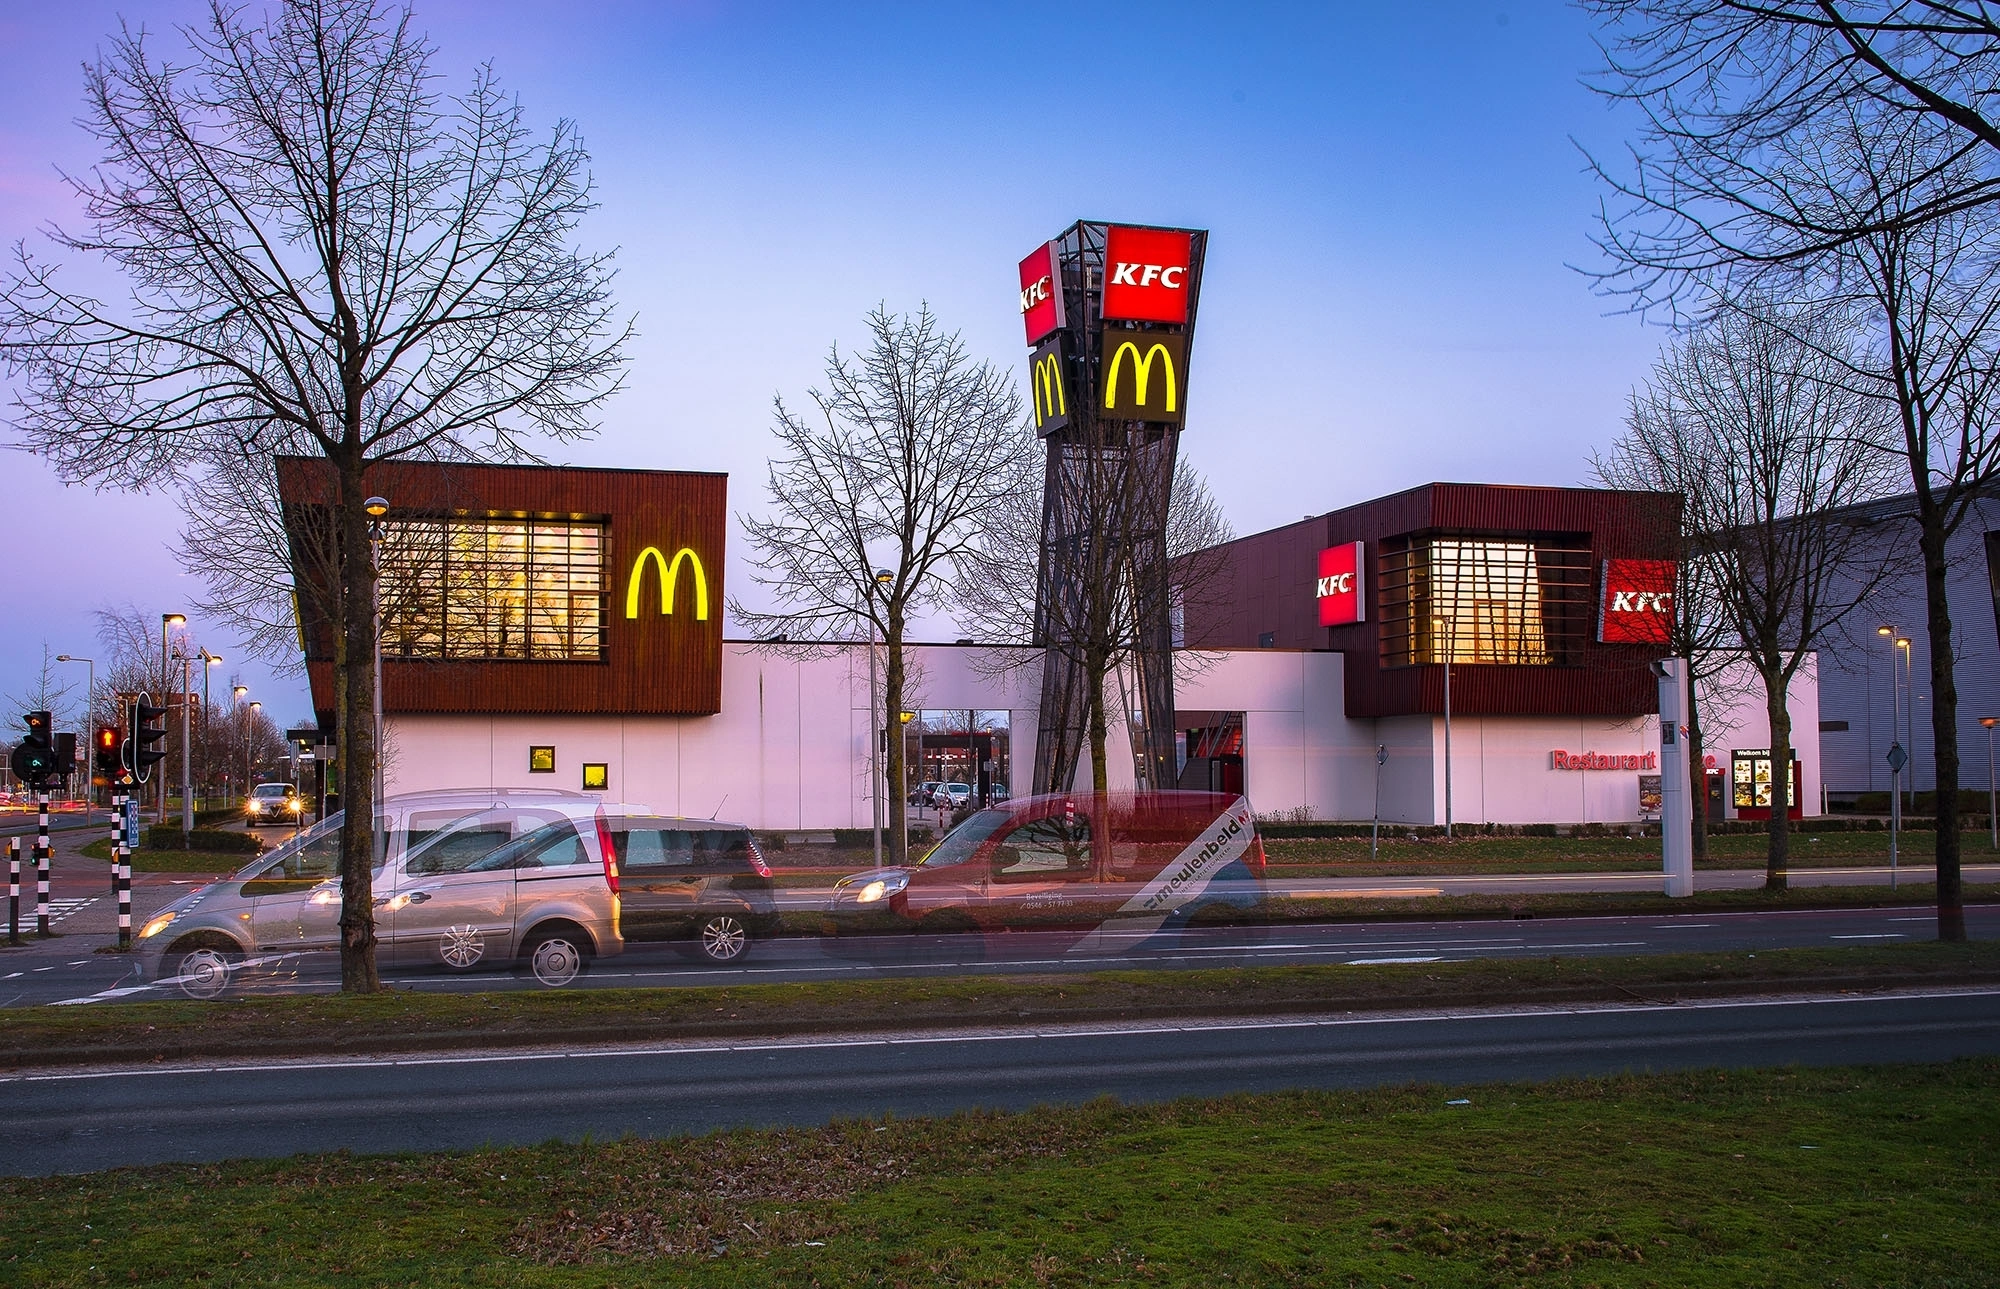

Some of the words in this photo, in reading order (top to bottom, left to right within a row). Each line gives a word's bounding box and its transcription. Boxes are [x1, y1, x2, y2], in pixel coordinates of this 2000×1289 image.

[1111, 262, 1186, 288] KFC
[1020, 275, 1050, 314] KFC
[1316, 572, 1355, 599] KFC
[1610, 591, 1673, 613] KFC
[1553, 749, 1657, 770] Restaurant
[1155, 819, 1241, 903] meulenbeld
